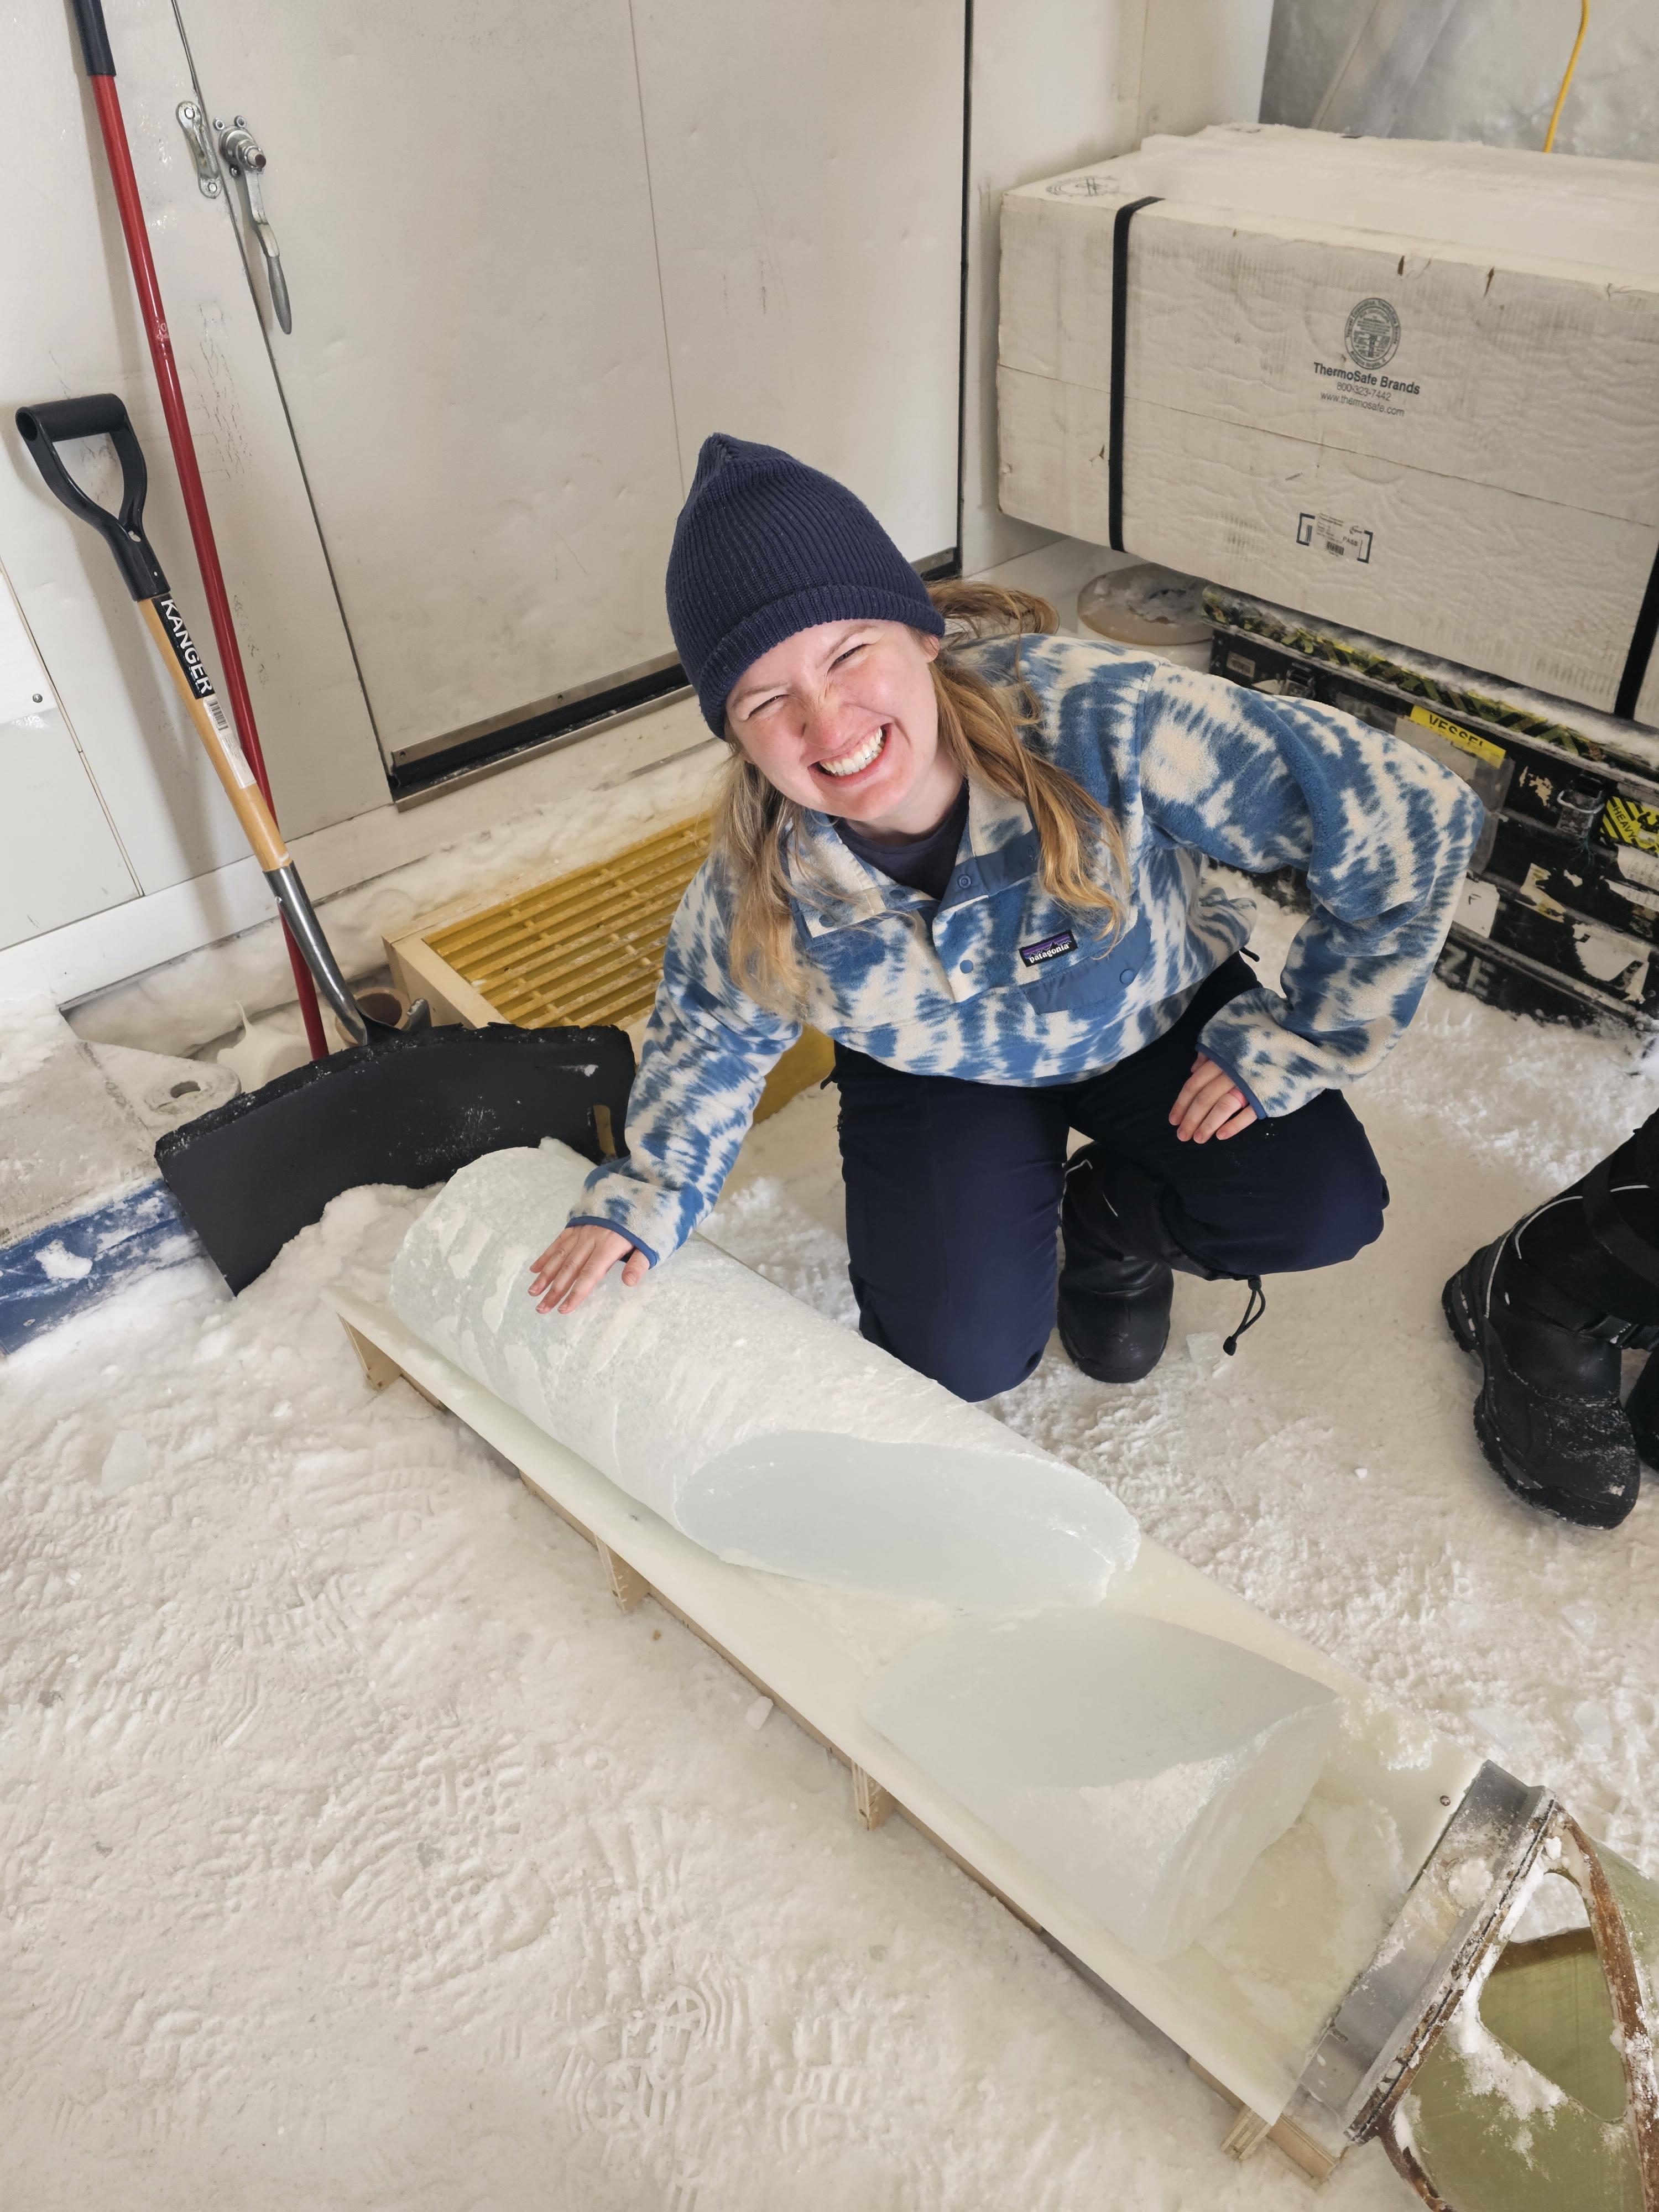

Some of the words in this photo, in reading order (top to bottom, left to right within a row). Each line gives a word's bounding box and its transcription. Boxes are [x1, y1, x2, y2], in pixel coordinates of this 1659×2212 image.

[1313, 362, 1378, 385] ThermoSafe
[1380, 375, 1421, 395] Brands
[1337, 382, 1392, 401] 800-323-7442
[1320, 392, 1405, 417] www.thermosafe.com
[160, 599, 212, 694] KANGER
[1613, 805, 1635, 839] HEAVY
[1029, 943, 1070, 963] patagonia
